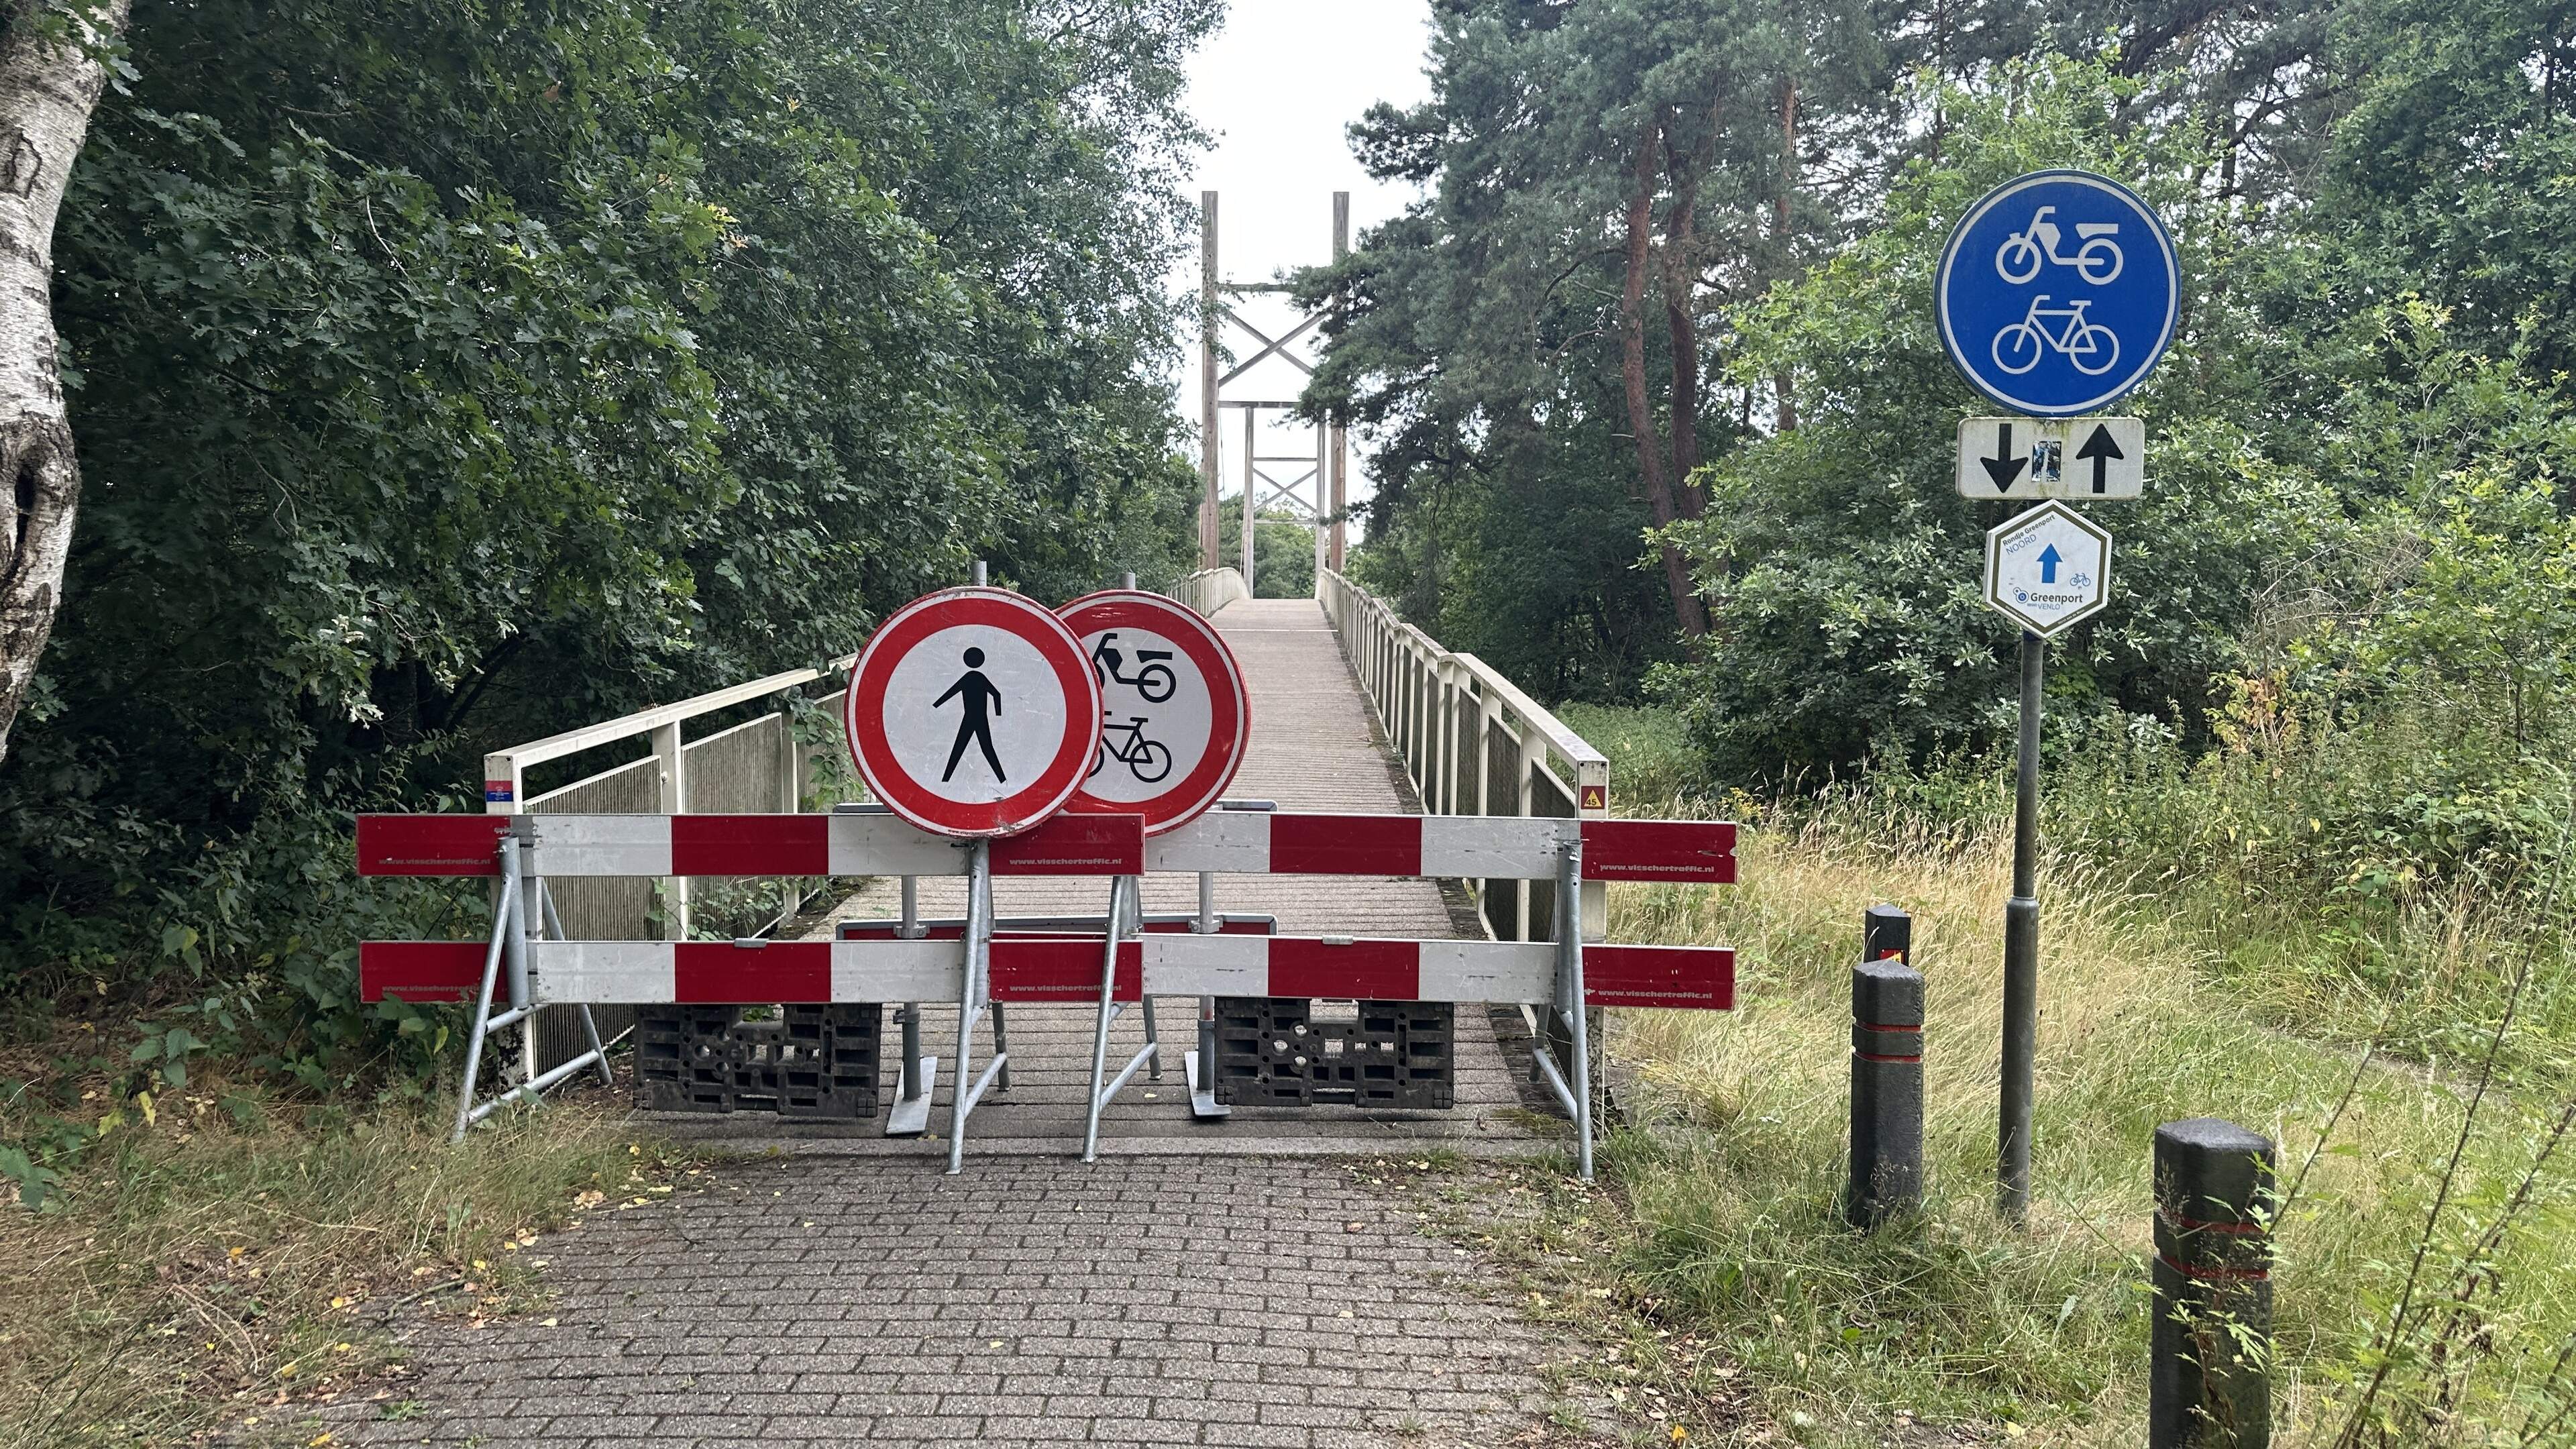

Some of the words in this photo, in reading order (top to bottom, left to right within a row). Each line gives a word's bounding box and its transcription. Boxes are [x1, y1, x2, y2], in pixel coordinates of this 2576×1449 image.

[2002, 532, 2024, 546] Rondje
[2025, 514, 2055, 534] Greenport
[2006, 534, 2037, 555] NOORD
[2031, 593, 2083, 604] Greenport
